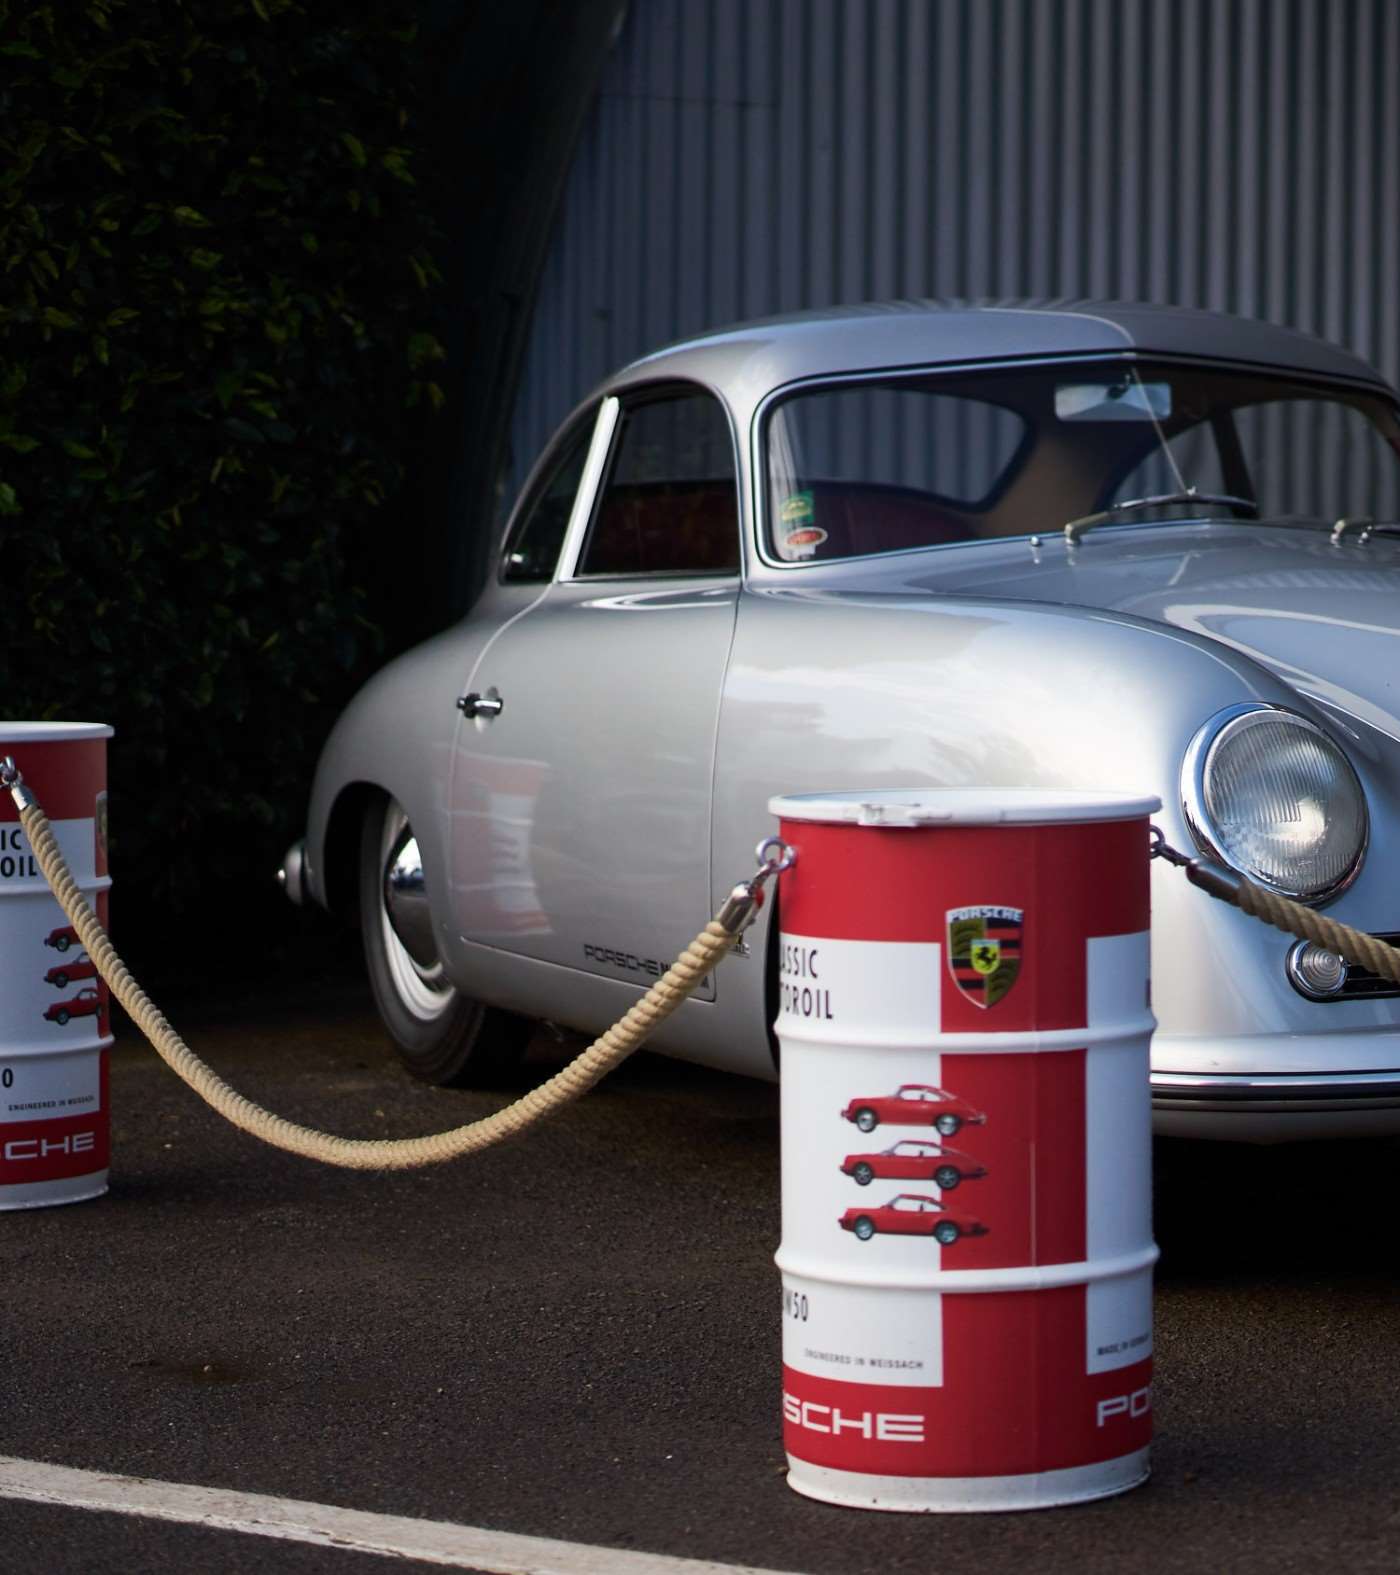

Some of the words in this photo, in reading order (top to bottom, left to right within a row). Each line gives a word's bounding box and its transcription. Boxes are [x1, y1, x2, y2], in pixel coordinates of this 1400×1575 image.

[947, 907, 1022, 923] PORSCHE
[584, 944, 660, 976] PORSCHE
[4, 1131, 96, 1161] CHE
